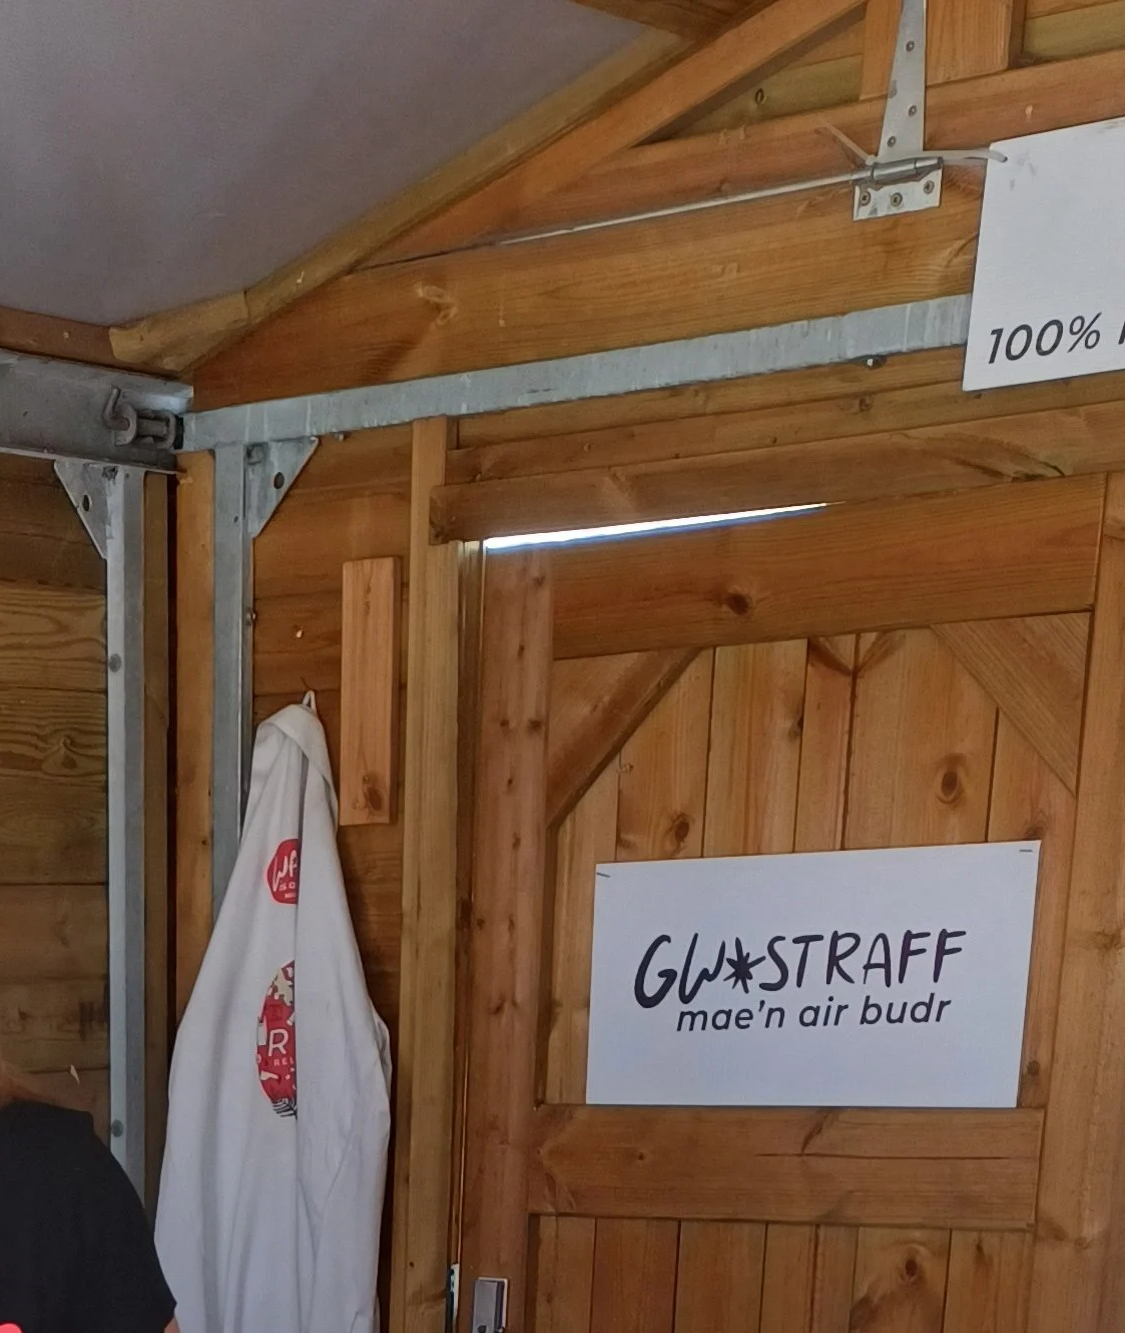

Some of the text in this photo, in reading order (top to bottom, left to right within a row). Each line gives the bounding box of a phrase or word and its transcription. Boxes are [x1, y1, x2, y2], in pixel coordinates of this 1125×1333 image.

[988, 312, 1102, 364] 100%
[676, 992, 952, 1033] mae'n air budr
